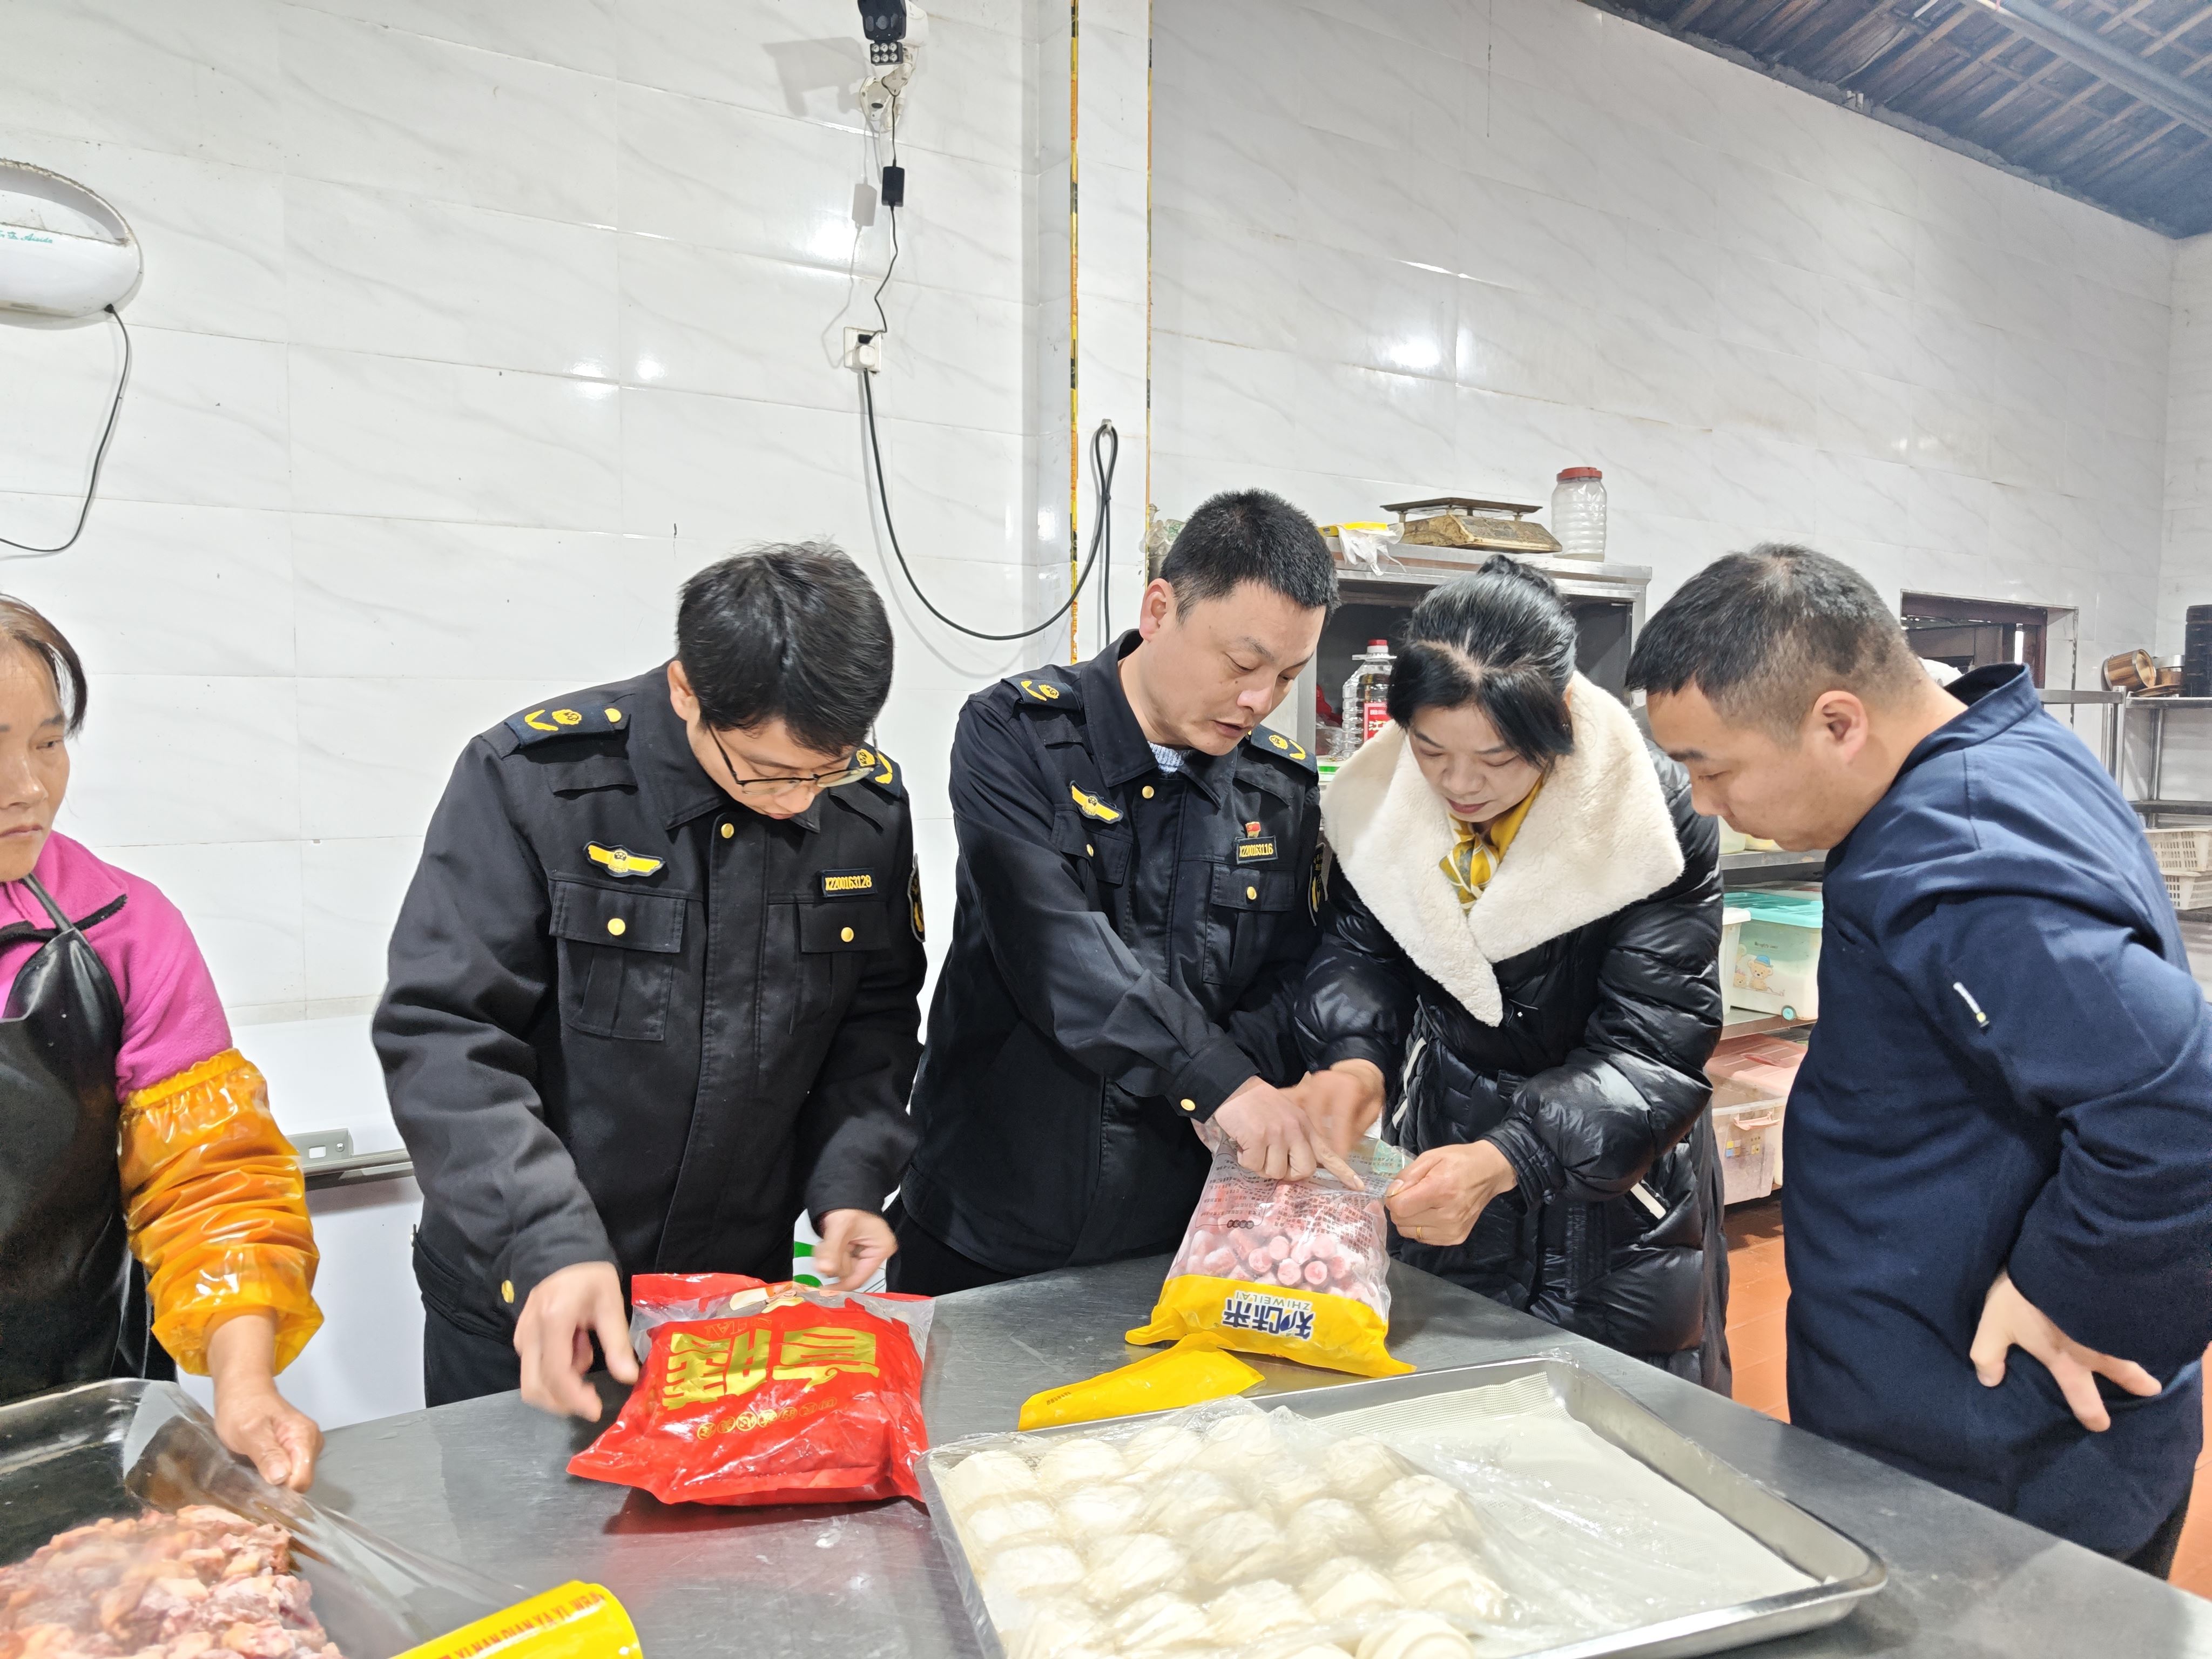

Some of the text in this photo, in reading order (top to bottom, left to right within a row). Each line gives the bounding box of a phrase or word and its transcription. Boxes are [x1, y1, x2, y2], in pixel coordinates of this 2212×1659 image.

[1236, 1292, 1310, 1311] ZHIWEILAI
[1223, 1299, 1314, 1339] 知味来
